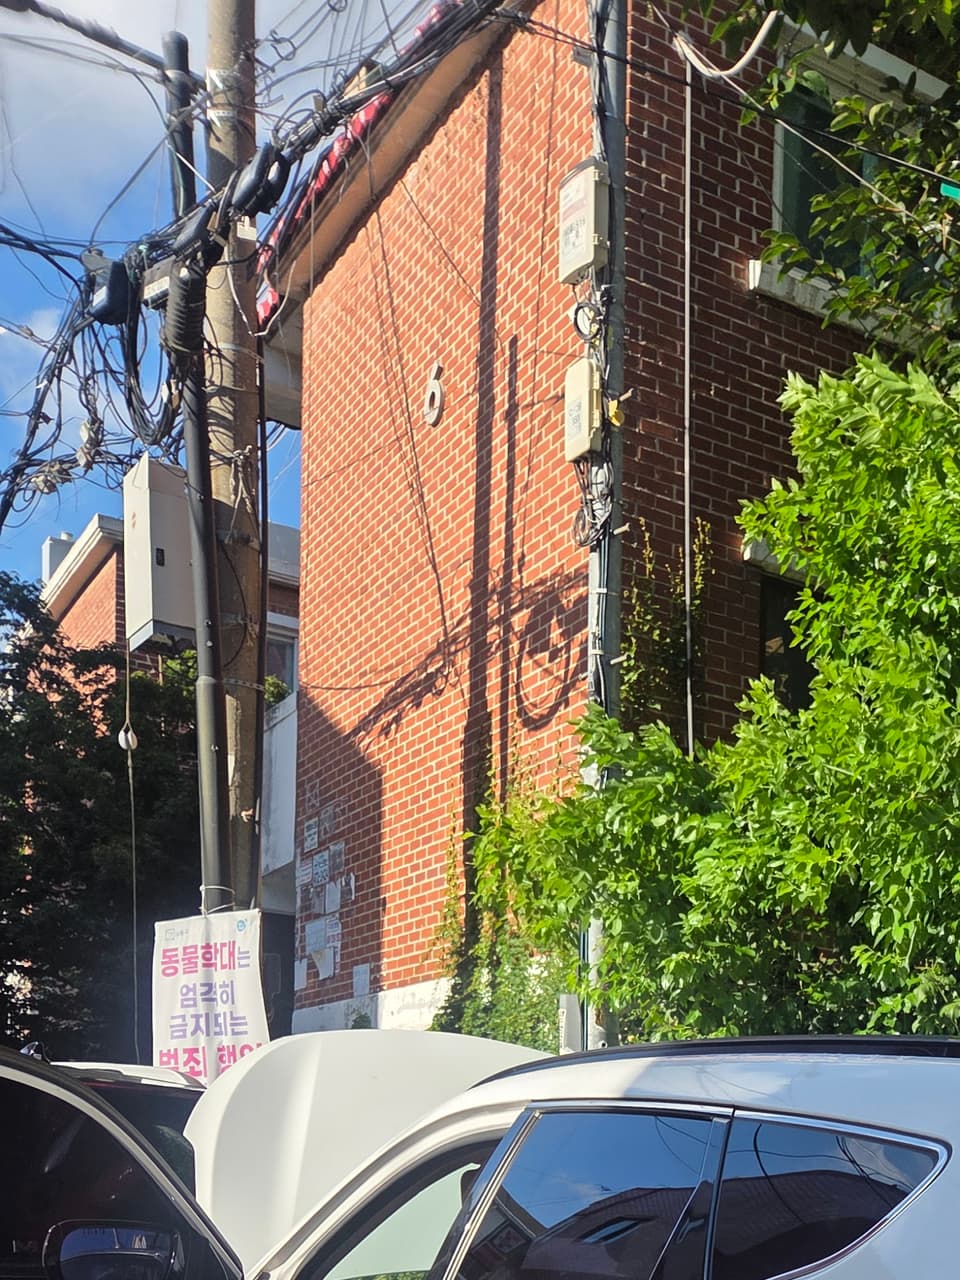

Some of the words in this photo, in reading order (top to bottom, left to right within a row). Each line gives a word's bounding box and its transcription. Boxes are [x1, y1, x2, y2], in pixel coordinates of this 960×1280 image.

[161, 939, 250, 977] 동물학대는
[180, 980, 235, 1008] 엄격히
[169, 1010, 248, 1040] 금지되는
